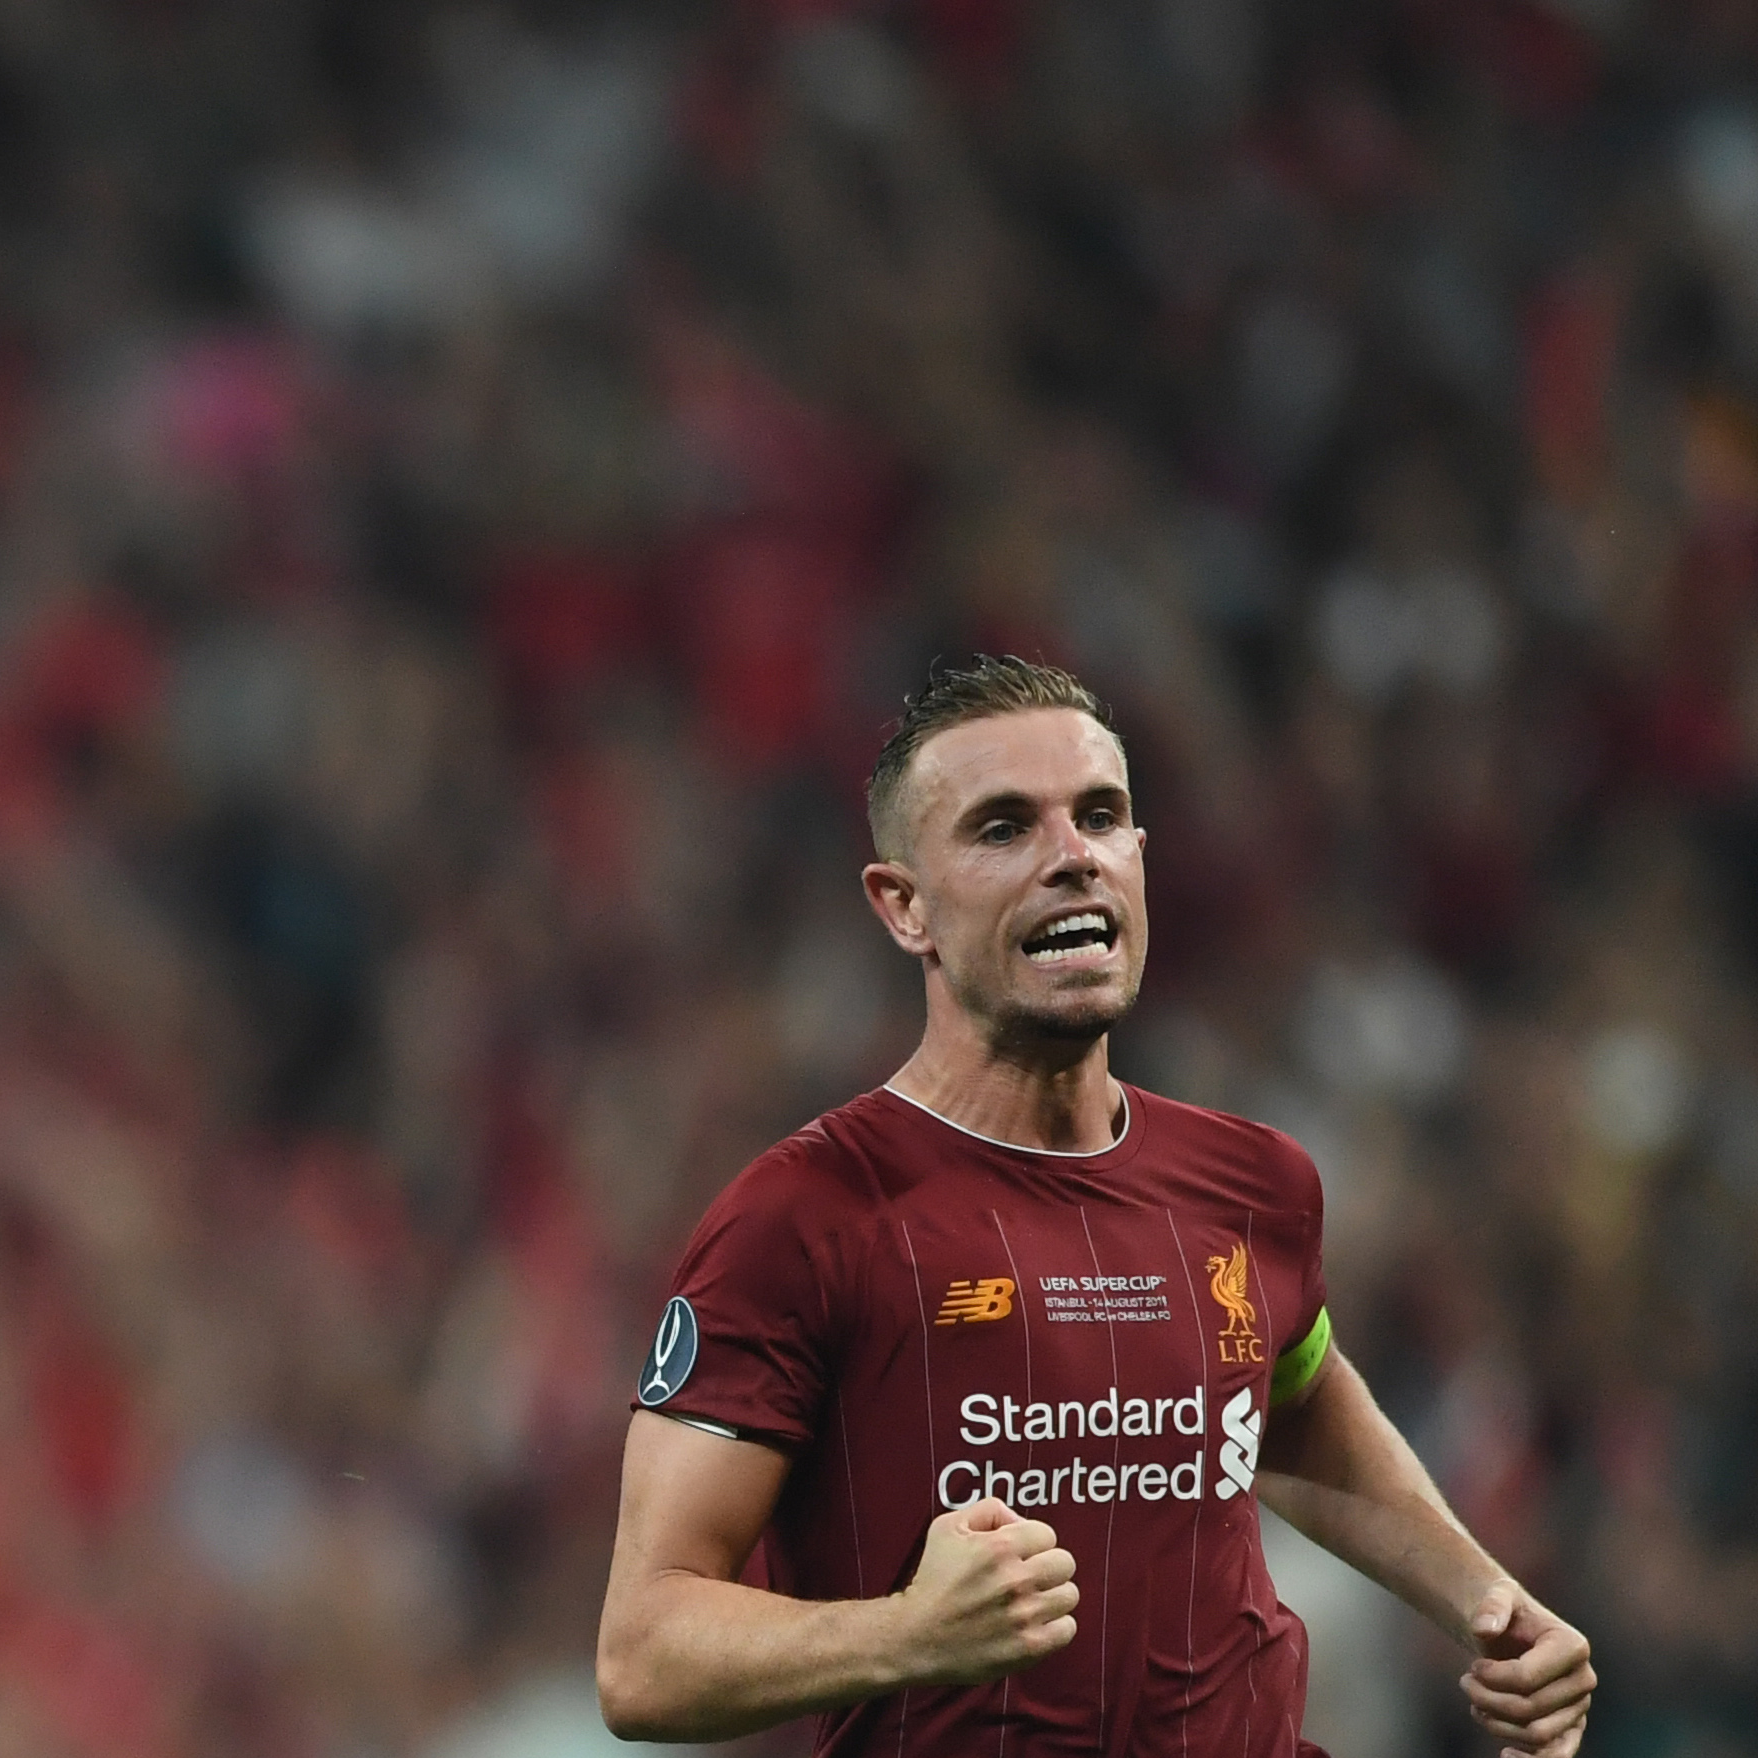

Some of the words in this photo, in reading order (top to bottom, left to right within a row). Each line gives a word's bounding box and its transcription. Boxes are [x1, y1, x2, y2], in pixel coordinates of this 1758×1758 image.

[1039, 1277, 1079, 1291] UEFA
[1080, 1276, 1129, 1291] SUPER
[1045, 1297, 1088, 1308] ISTANBUL
[1104, 1296, 1145, 1308] AUGUST
[1047, 1311, 1094, 1322] LIVERPOOL
[1117, 1311, 1157, 1321] CHELSEA
[960, 1385, 1205, 1445] Standard
[938, 1450, 1203, 1511] Chartered
